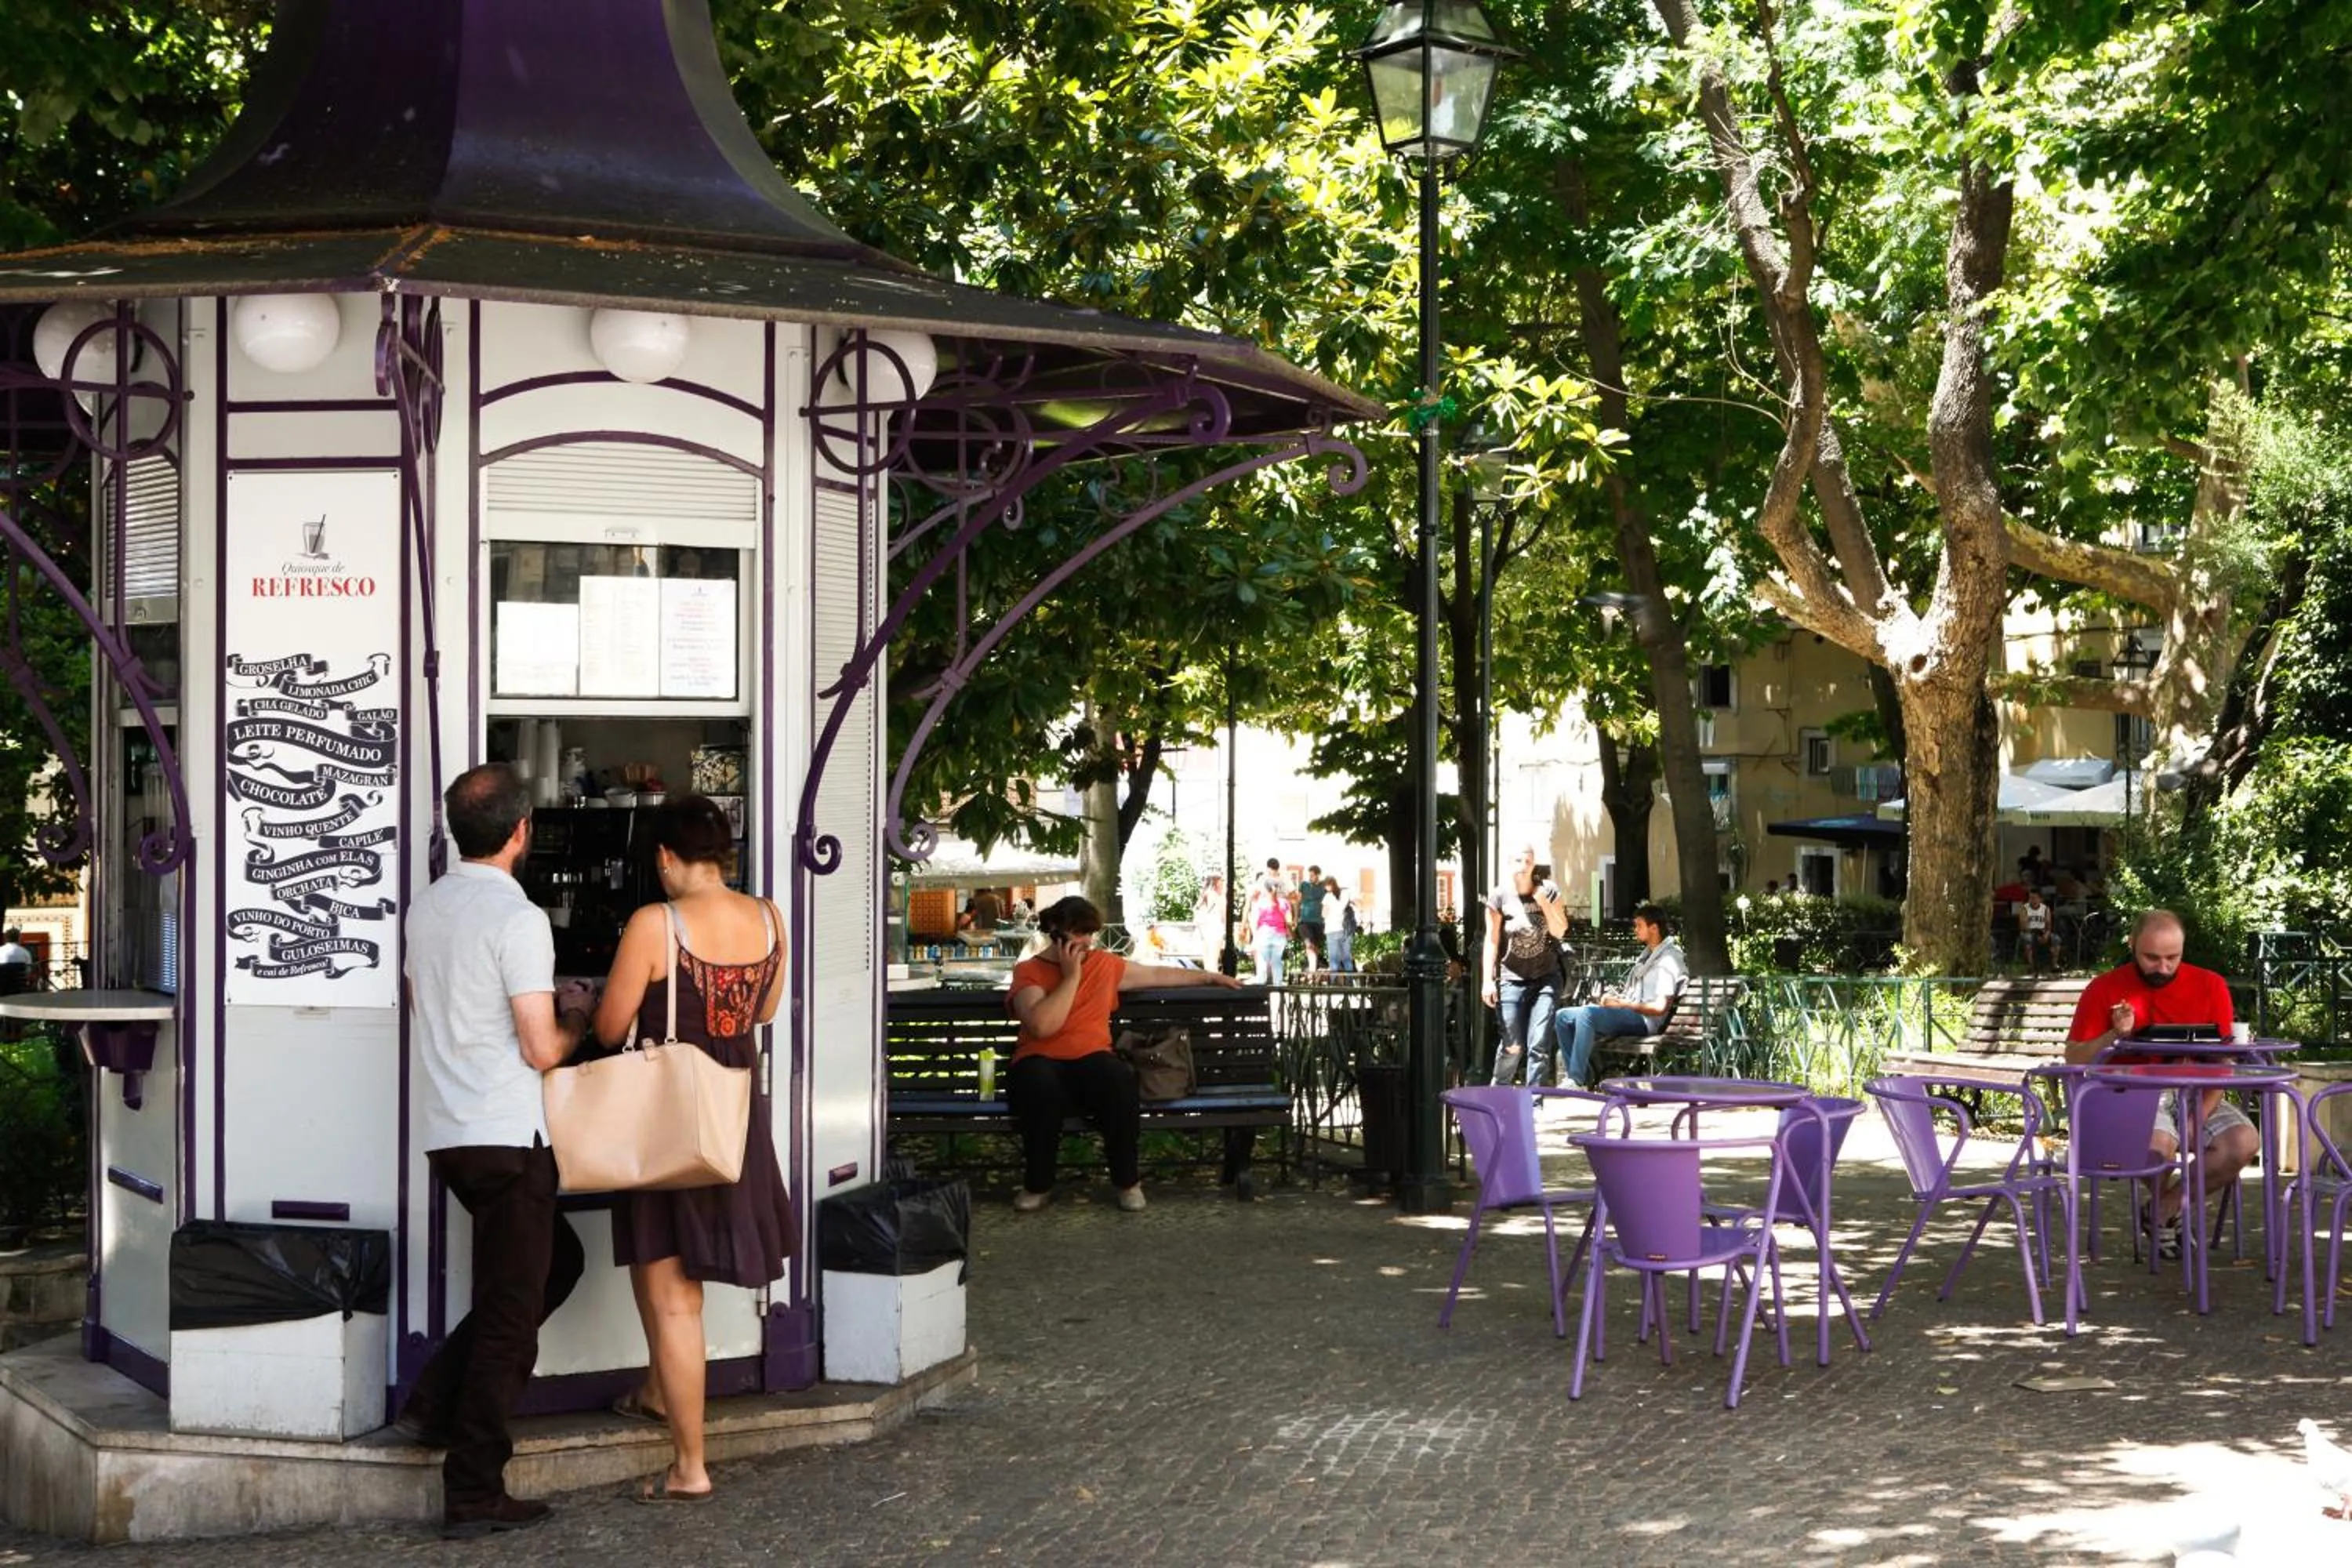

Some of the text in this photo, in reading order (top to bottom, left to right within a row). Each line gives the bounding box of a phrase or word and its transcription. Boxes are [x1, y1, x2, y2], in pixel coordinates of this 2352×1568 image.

[252, 576, 376, 597] REFRESCO
[239, 655, 308, 676] GROSELHA
[289, 673, 375, 697] LIMONADA CHIC
[280, 700, 325, 719] GELADO
[234, 724, 381, 761] LEITE PERFUMADO
[322, 766, 389, 786] MAZAGRAN
[240, 779, 328, 805] CHOCOLATE
[263, 812, 354, 836] VINHO QUENTE
[339, 829, 384, 848] CAPILÉ
[252, 858, 314, 880] GINGINHA
[339, 851, 375, 866] ELAS
[277, 877, 333, 899] ORCHATA
[329, 902, 361, 918] BICA
[234, 910, 330, 938] VINHO DO PORTO
[281, 940, 370, 960] GULOSEIMAS
[278, 966, 289, 975] de
